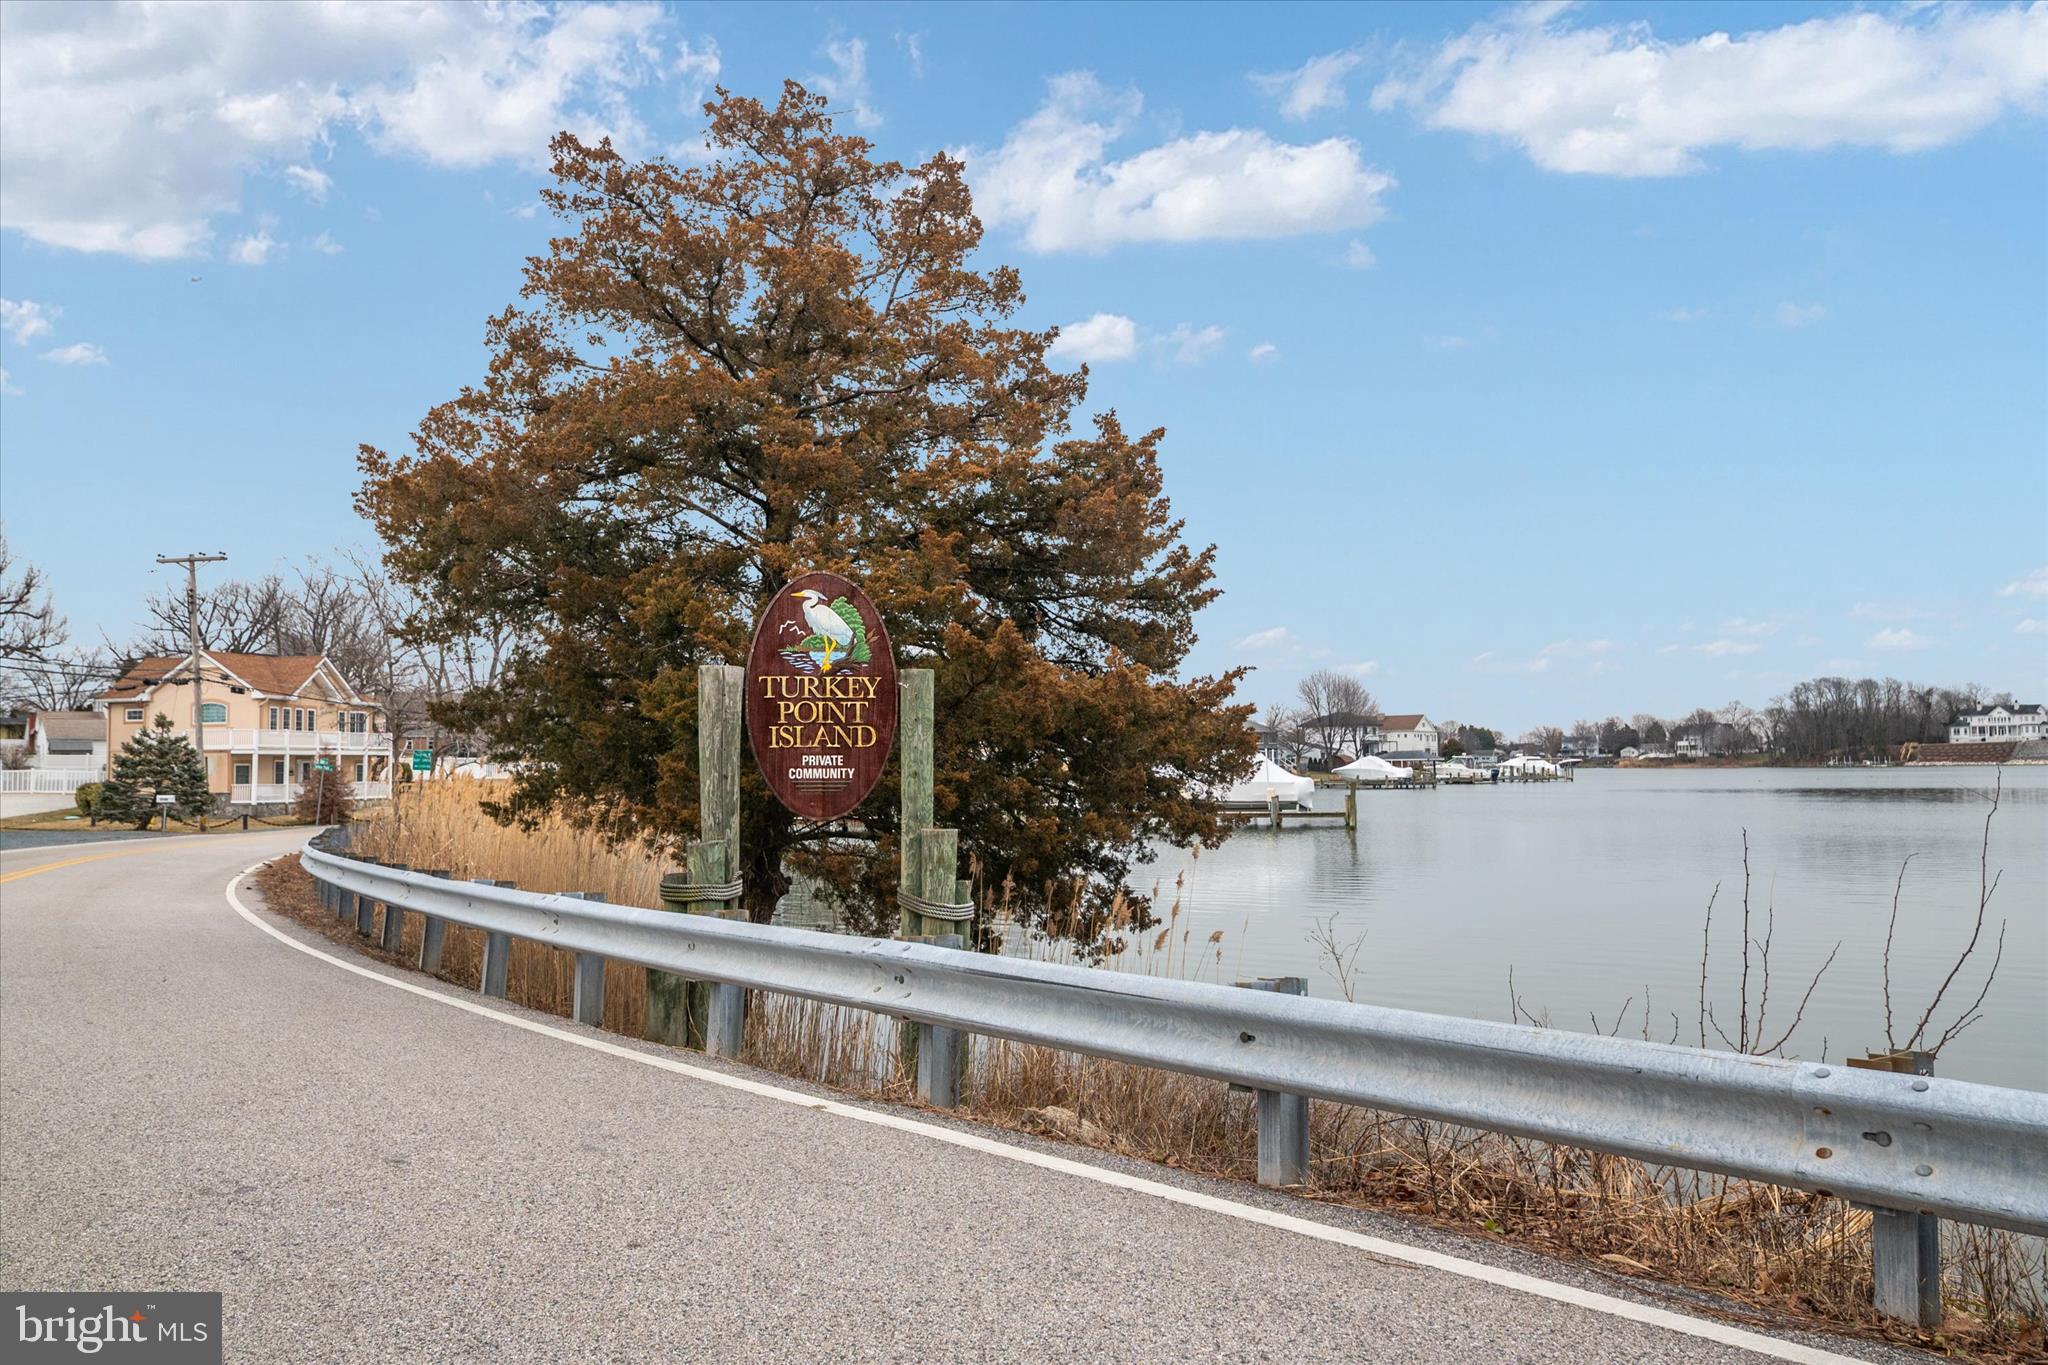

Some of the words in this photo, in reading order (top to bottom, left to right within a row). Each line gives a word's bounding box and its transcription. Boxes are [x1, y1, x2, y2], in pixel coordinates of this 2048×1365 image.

[759, 676, 882, 699] TURKEY
[777, 701, 869, 724] POINT
[768, 725, 877, 749] ISLAND
[802, 755, 844, 766] PRIVATE
[789, 768, 855, 779] COMMUNITY
